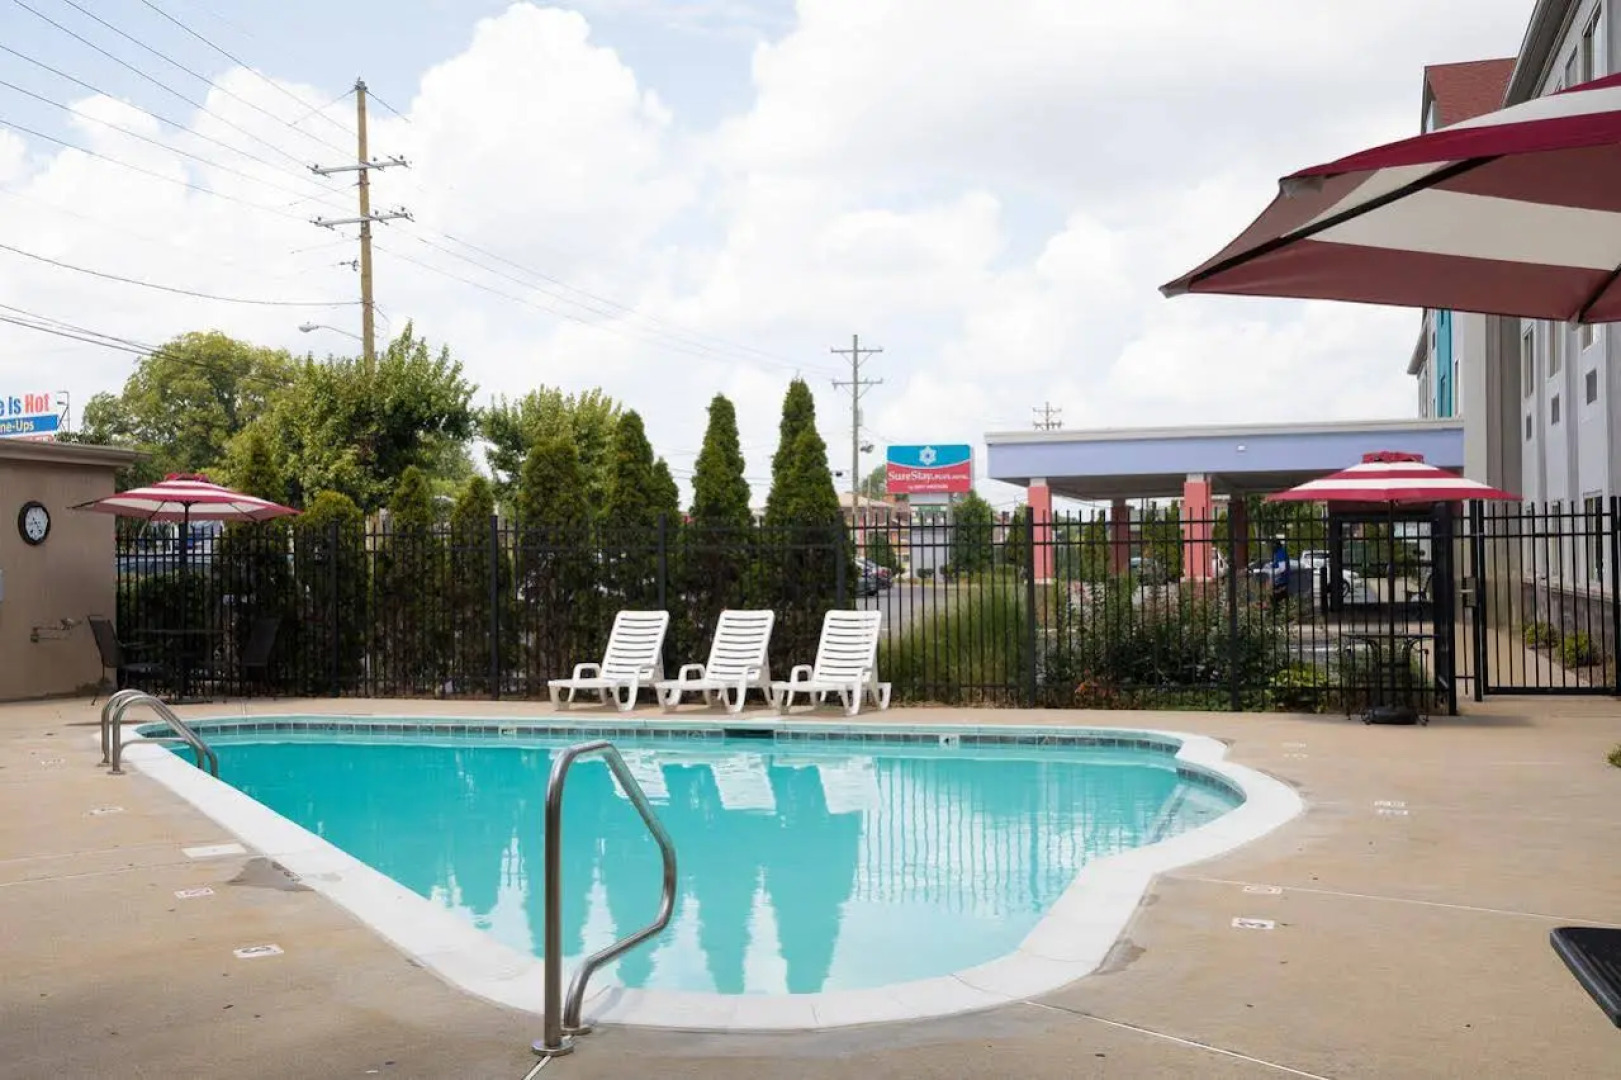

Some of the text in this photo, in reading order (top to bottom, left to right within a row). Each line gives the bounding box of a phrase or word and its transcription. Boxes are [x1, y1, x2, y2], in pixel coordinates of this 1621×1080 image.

[8, 396, 21, 416] Is
[25, 394, 49, 414] Hot
[888, 471, 932, 483] SureStay
